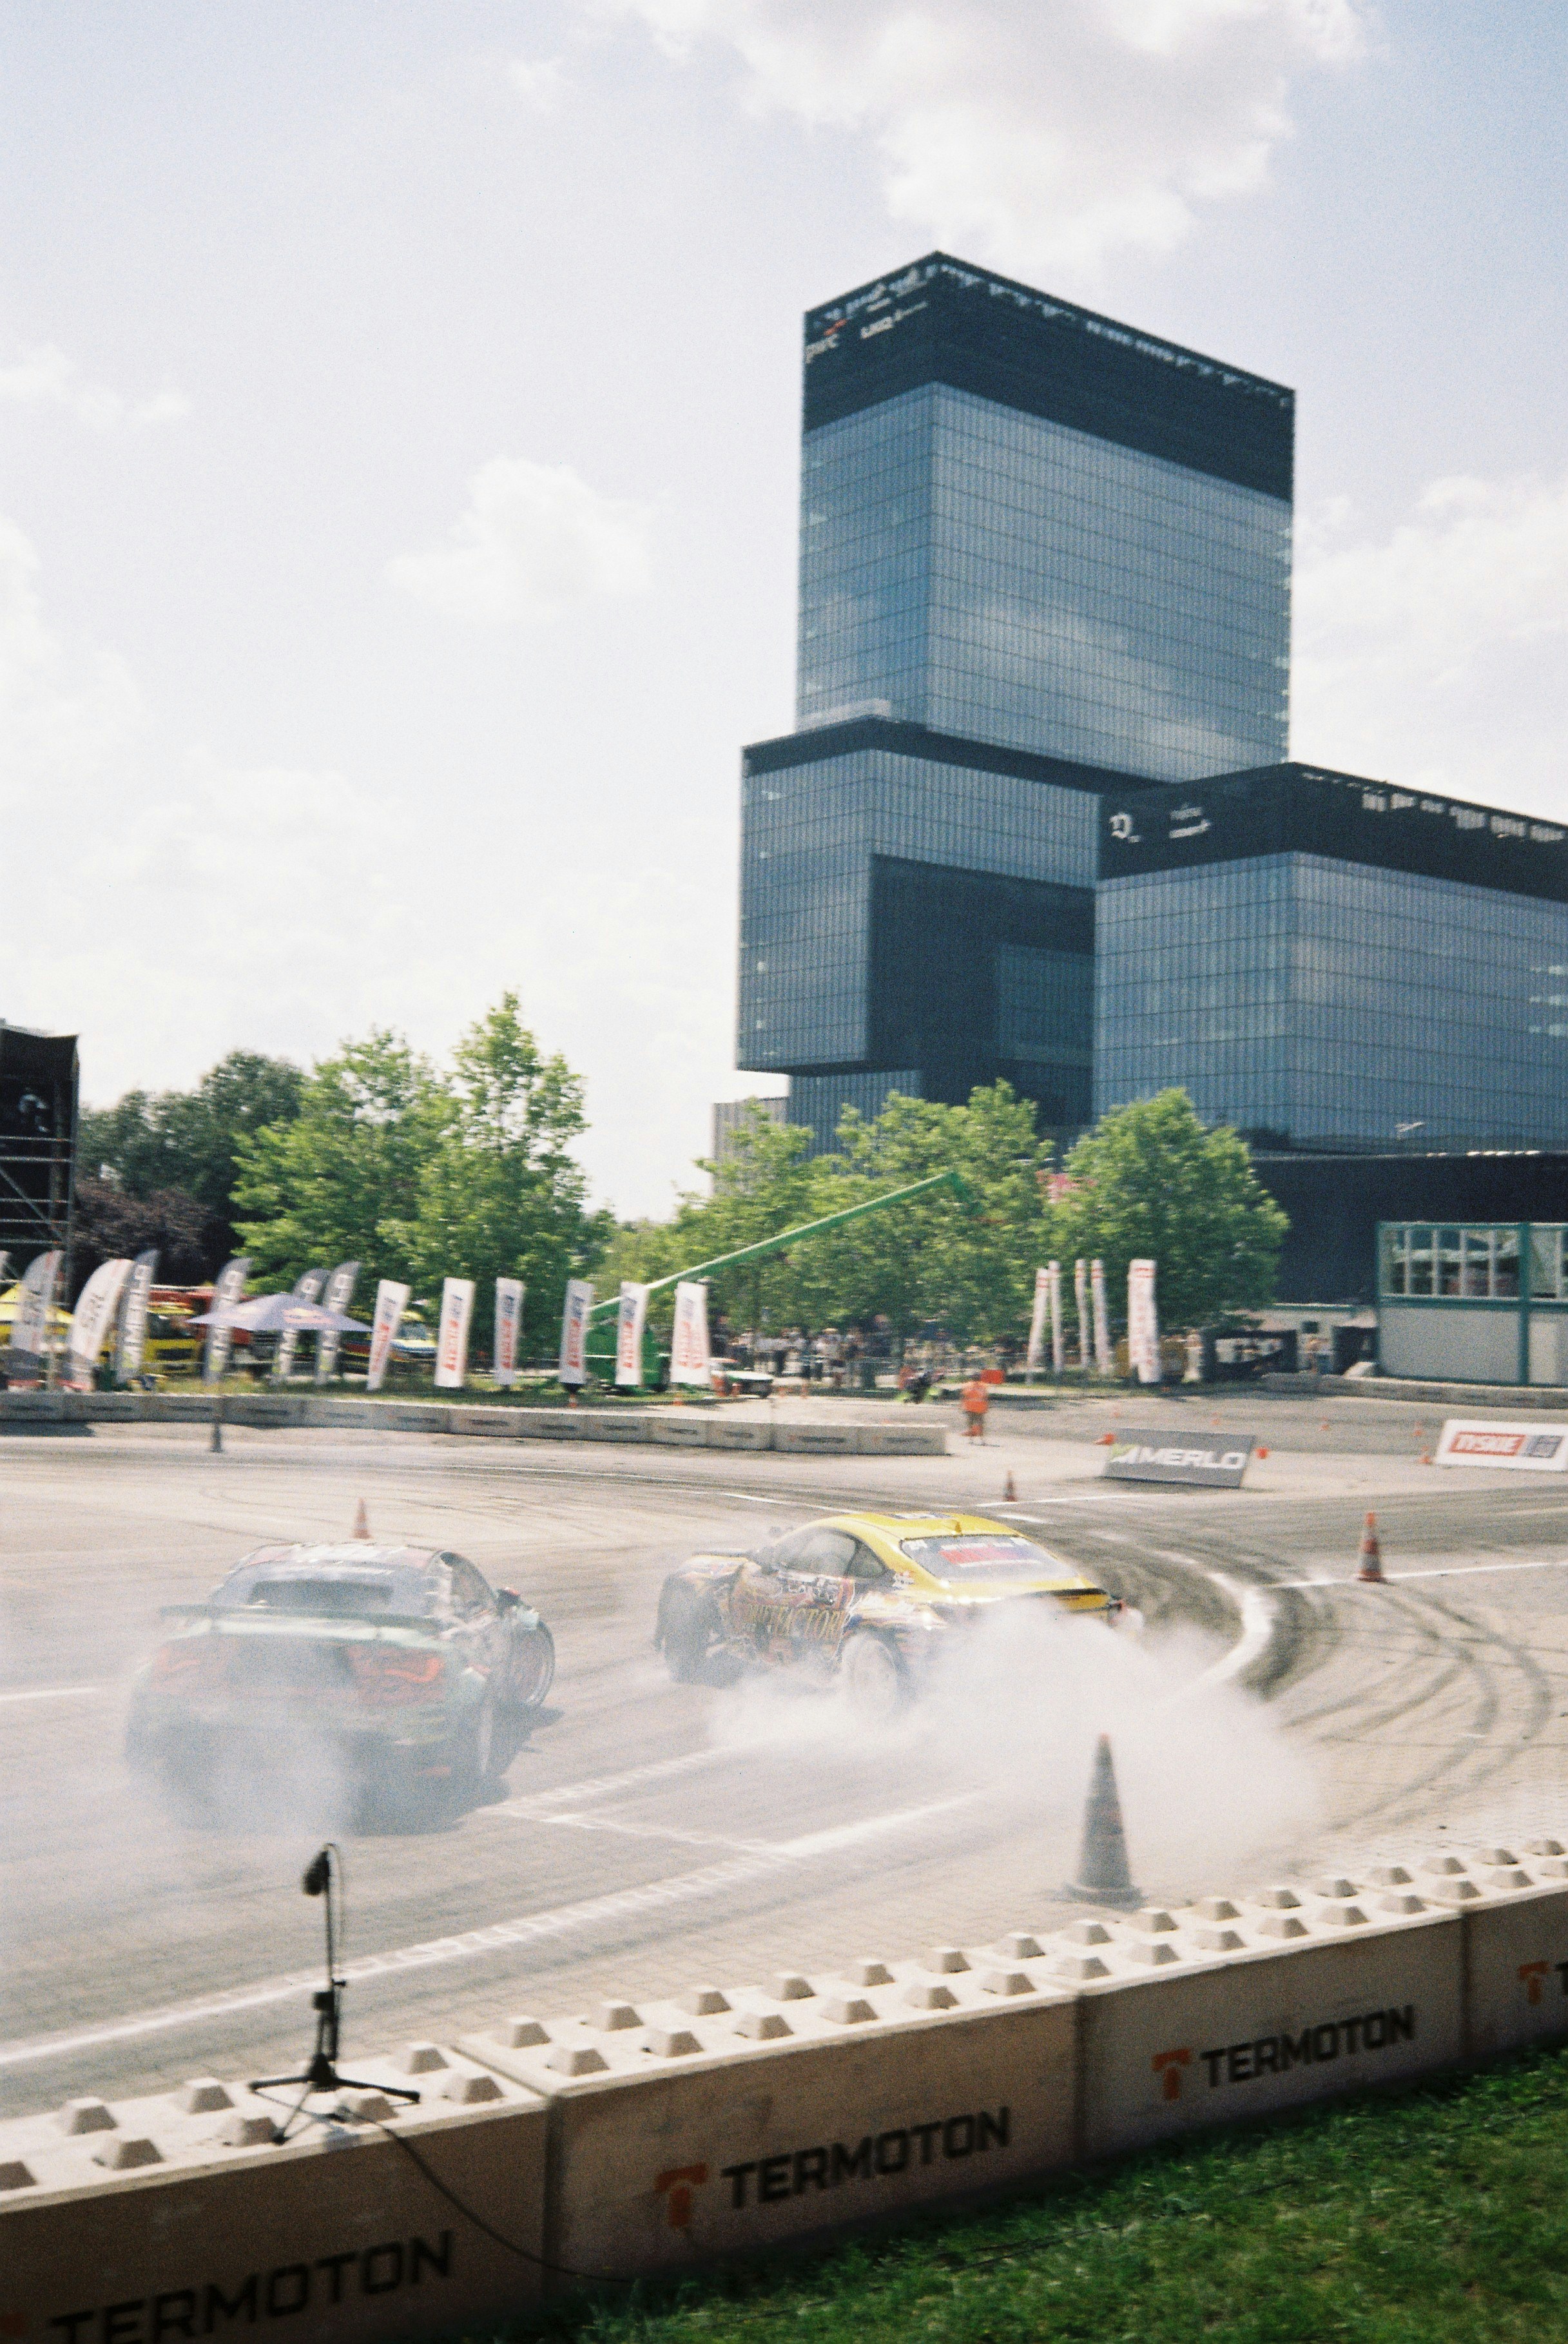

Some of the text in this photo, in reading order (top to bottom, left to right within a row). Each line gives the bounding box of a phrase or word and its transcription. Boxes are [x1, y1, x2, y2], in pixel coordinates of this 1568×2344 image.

[1136, 1446, 1248, 1470] MERLO
[1199, 2004, 1414, 2087] TERMOTON
[721, 2106, 1011, 2209] TERMOTON
[49, 2229, 454, 2344] TERMOTON
